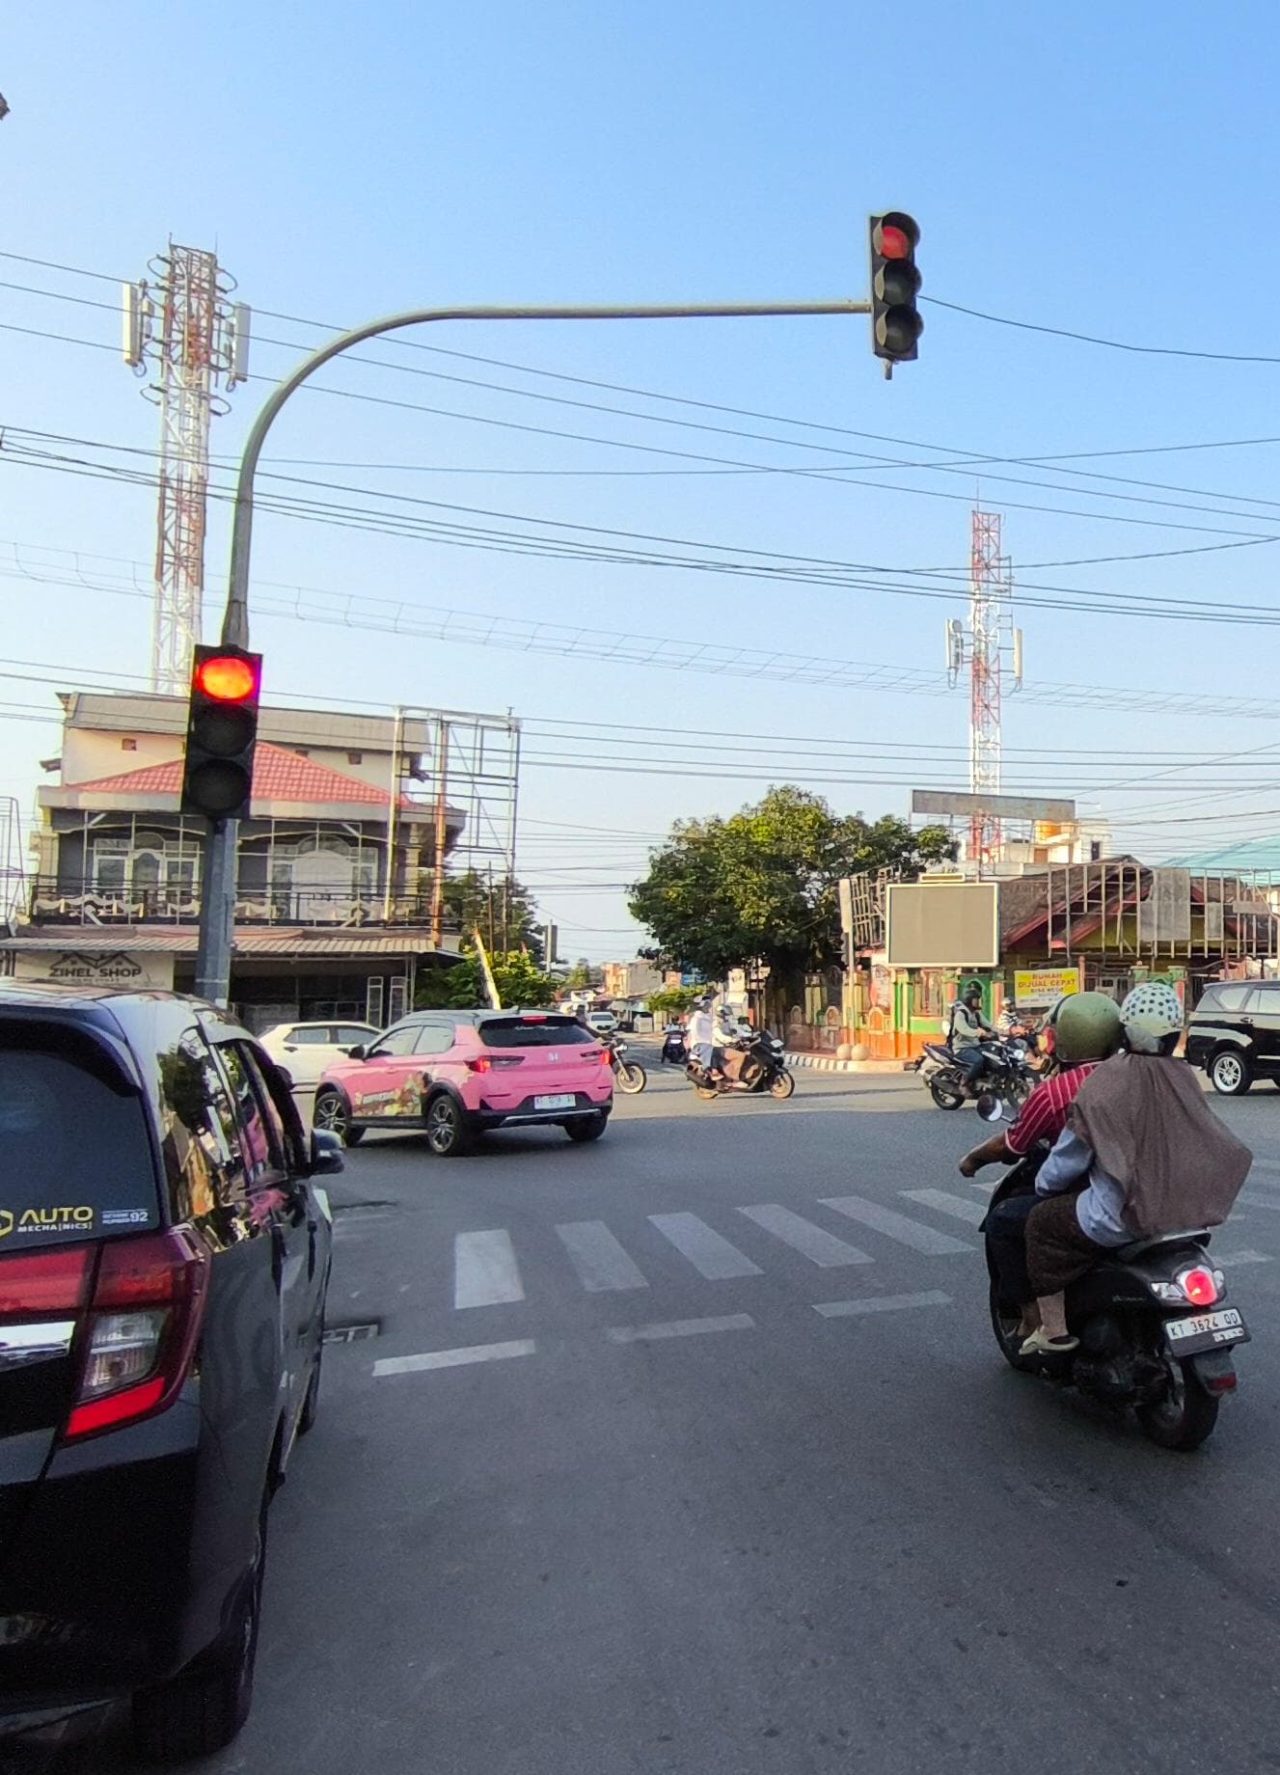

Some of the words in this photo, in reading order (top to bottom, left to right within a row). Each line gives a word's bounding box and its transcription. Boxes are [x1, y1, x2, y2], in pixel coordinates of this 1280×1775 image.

[100, 967, 142, 978] SHOP
[19, 1206, 93, 1225] AUTO
[130, 1211, 149, 1222] 92
[1170, 1324, 1185, 1337] KT
